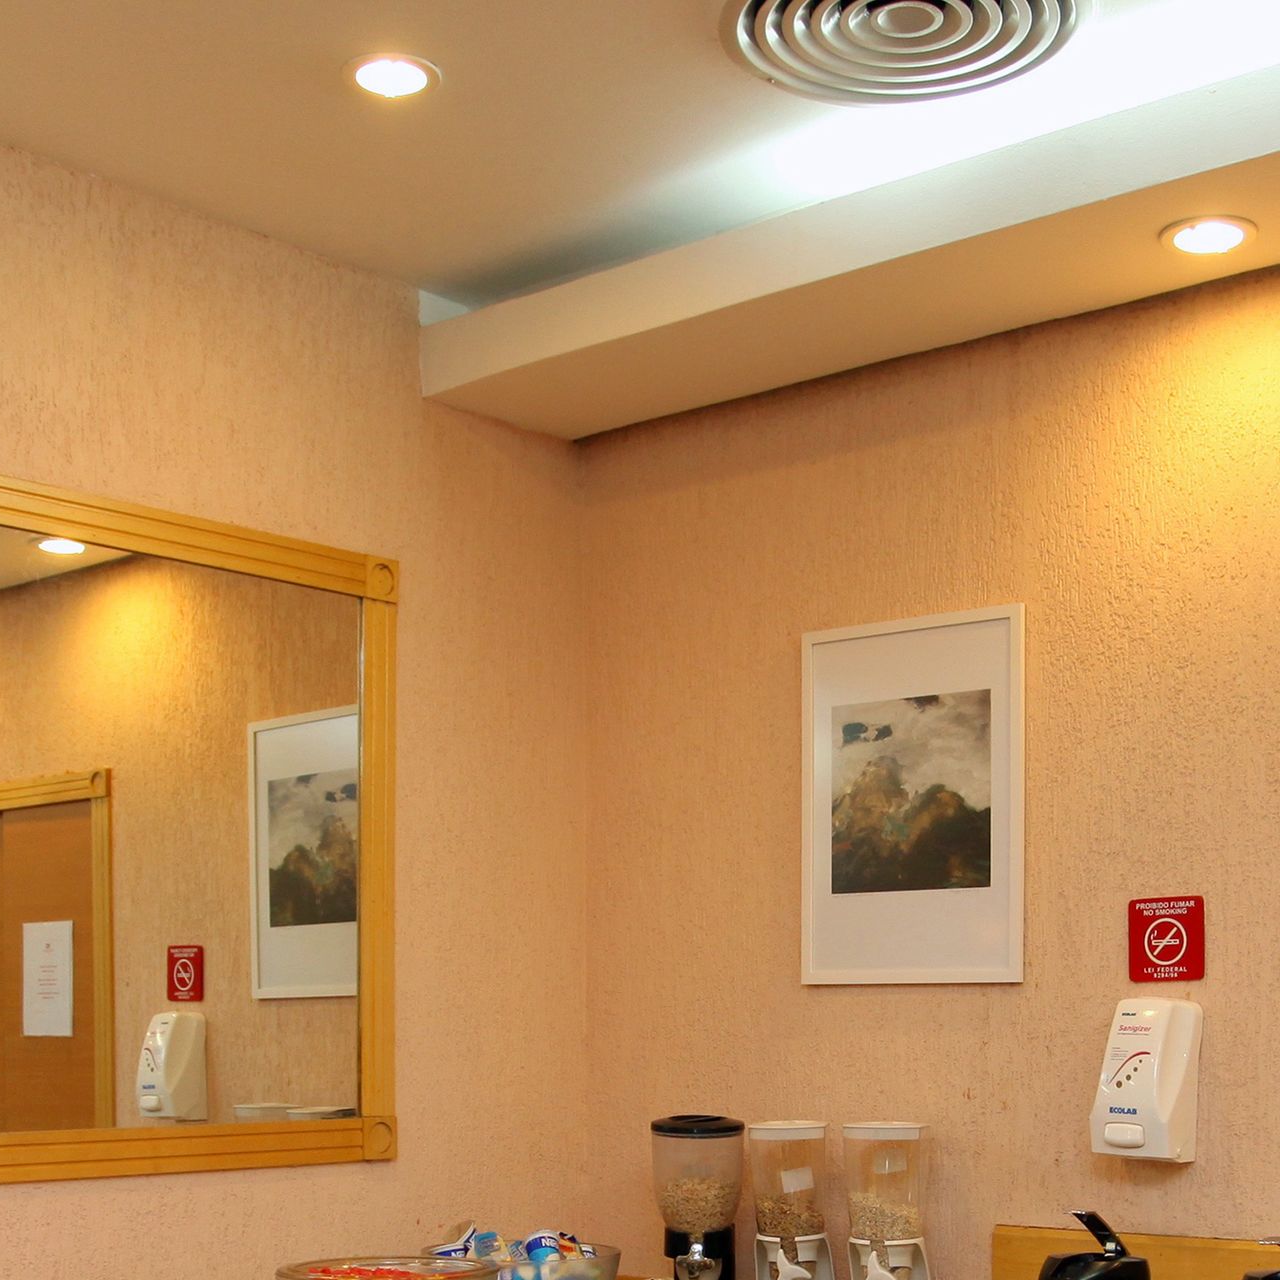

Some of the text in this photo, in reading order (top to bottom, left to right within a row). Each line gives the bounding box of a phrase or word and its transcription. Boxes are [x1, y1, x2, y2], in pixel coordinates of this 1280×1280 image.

[1136, 900, 1195, 910] PROIBIDO FUMAR
[1155, 908, 1187, 916] SMOKING
[1108, 1106, 1137, 1115] ECOLAB
